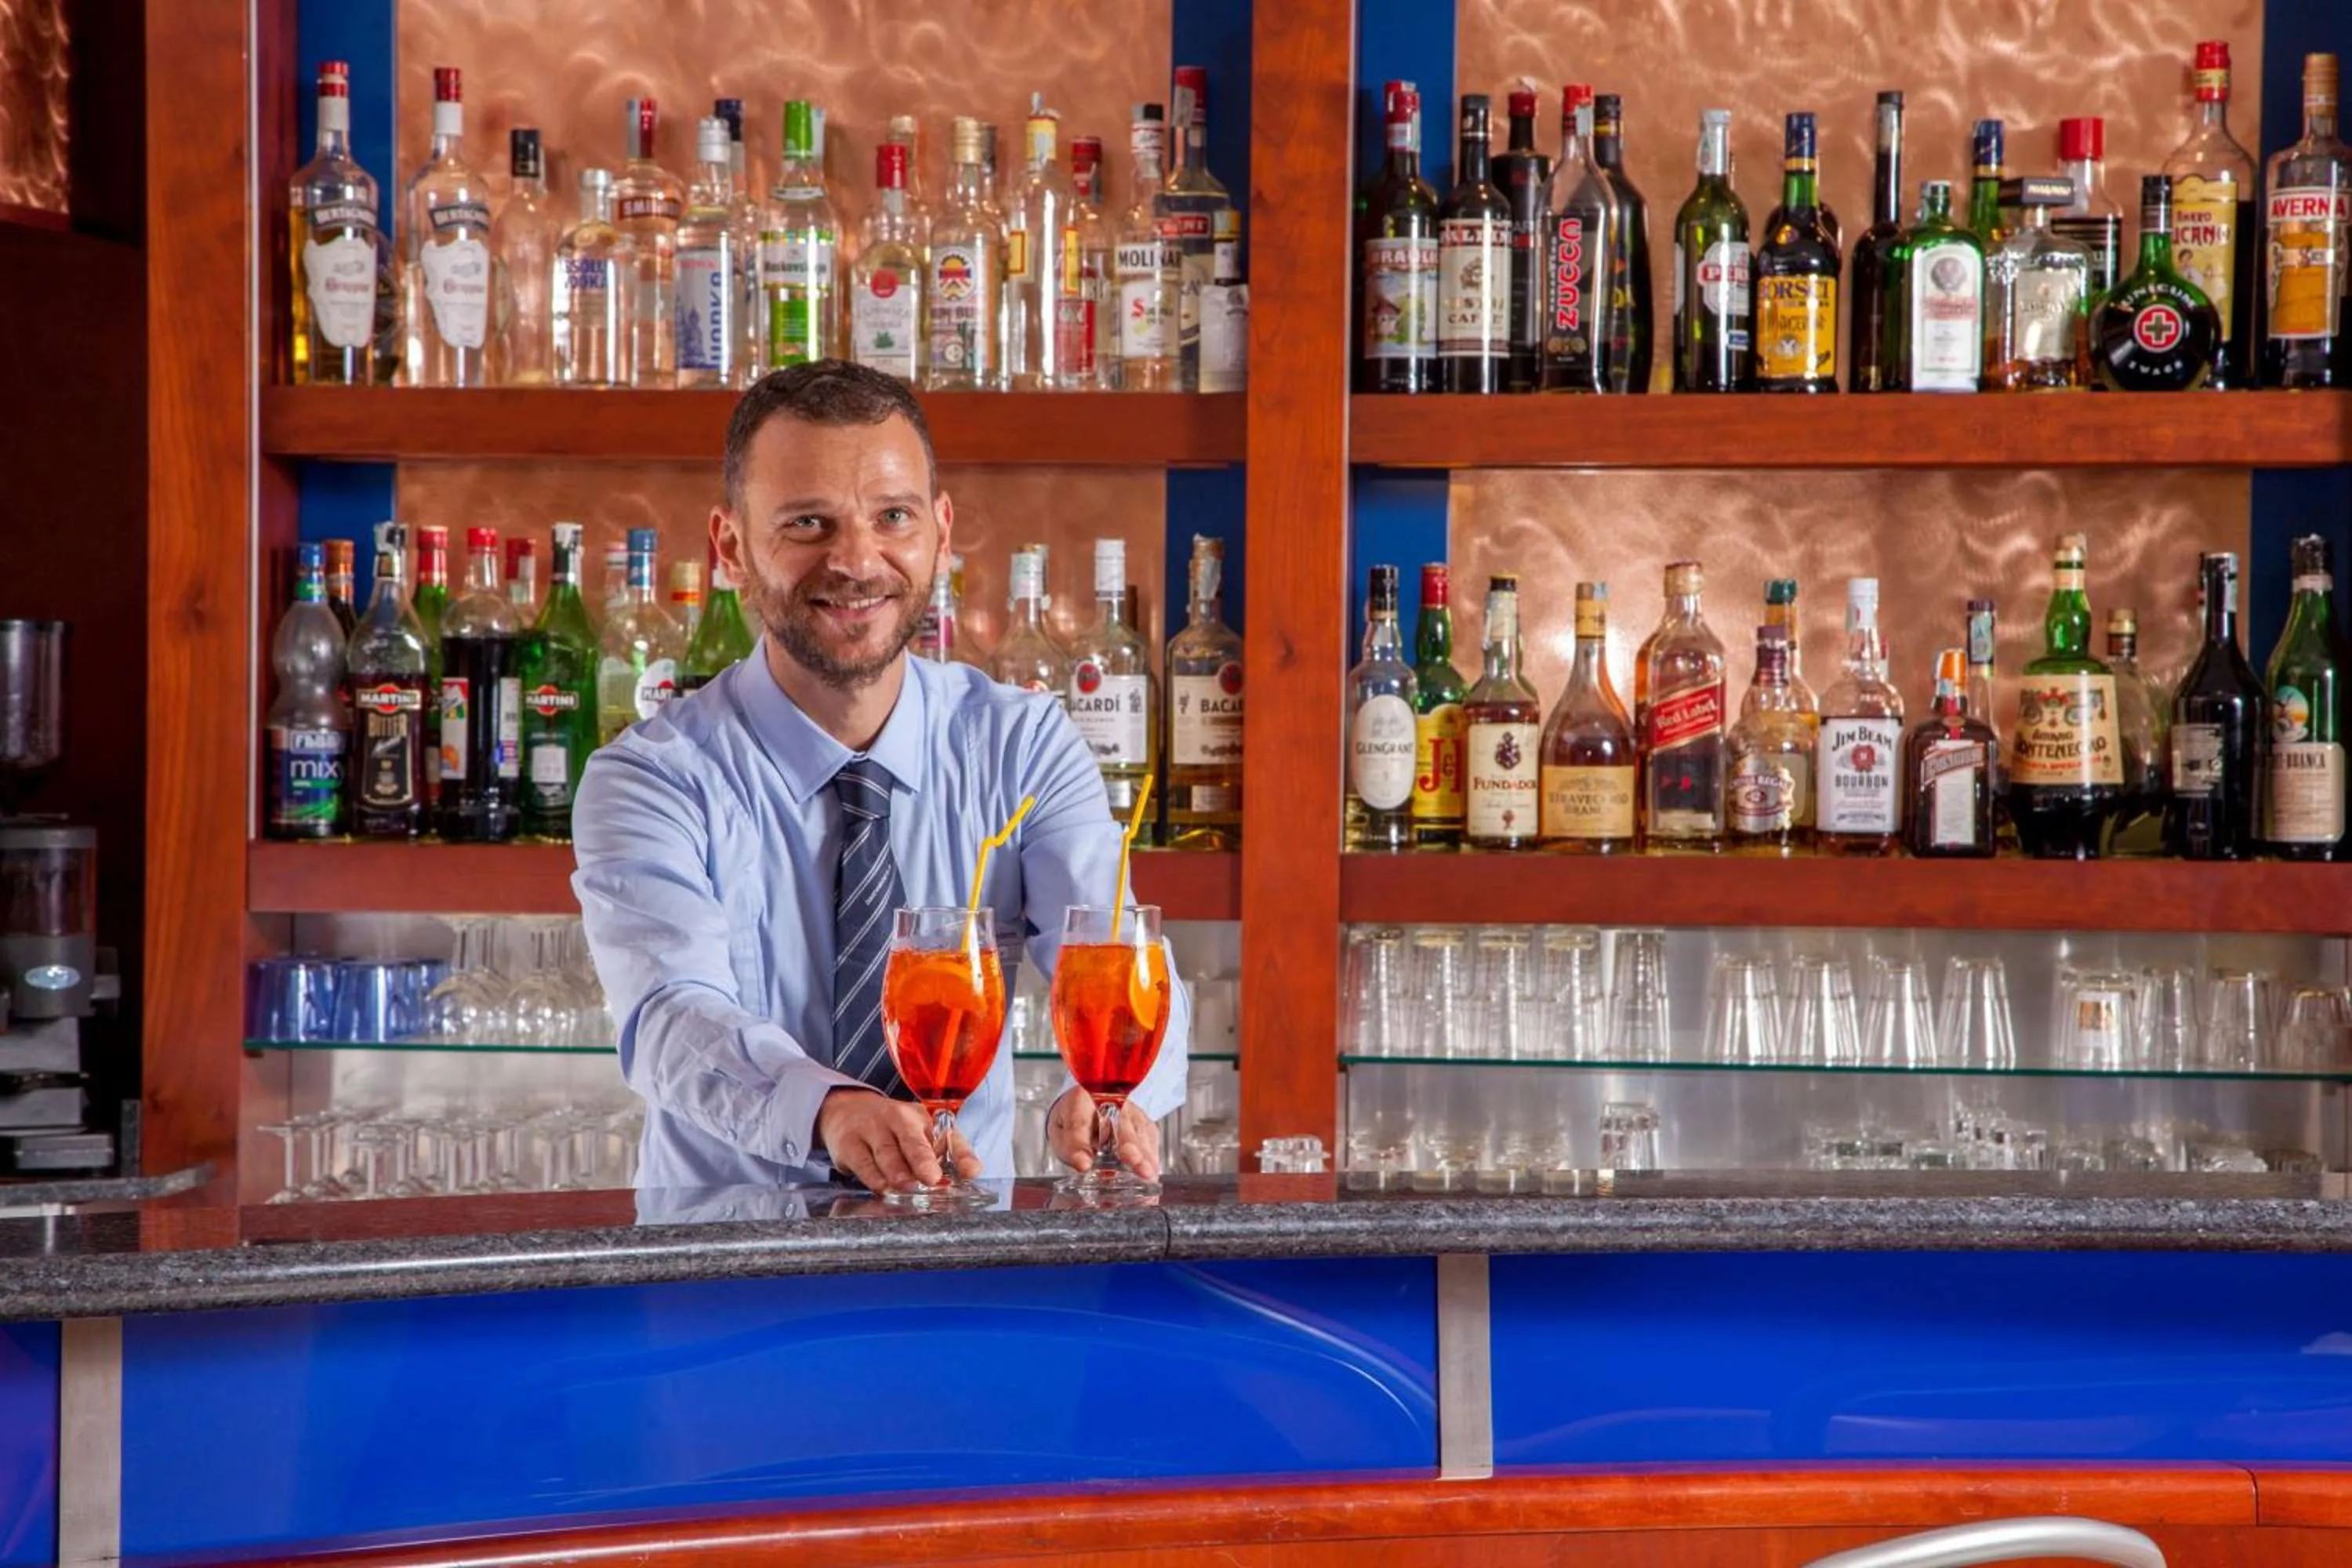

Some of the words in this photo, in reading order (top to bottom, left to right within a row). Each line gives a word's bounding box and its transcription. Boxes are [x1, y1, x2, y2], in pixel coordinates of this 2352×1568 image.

[2271, 197, 2347, 217] AVERNA
[2120, 284, 2197, 310] UNICUM
[526, 695, 575, 706] MARTINI
[641, 687, 673, 702] MART
[1069, 693, 1120, 713] ACARDÍ
[1656, 710, 1681, 729] Red
[1684, 698, 1719, 719] Label
[1832, 726, 1855, 752] JIM
[1858, 725, 1893, 750] BEAM
[291, 758, 339, 779] mix
